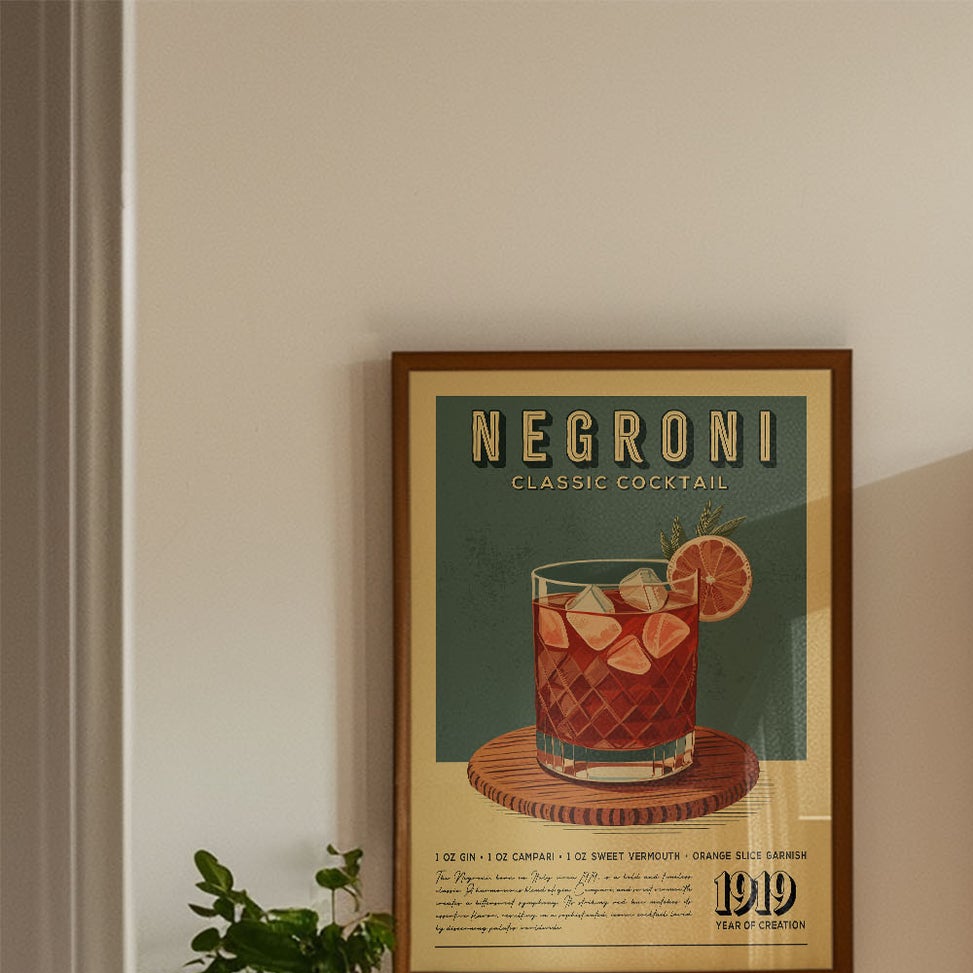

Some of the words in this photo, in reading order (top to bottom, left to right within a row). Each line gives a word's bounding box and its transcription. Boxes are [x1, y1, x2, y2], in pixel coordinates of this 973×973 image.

[471, 409, 775, 467] NEGRONI
[511, 474, 608, 491] CLASSIC
[616, 474, 729, 491] COCKTAIL
[435, 852, 439, 862] 1
[443, 852, 456, 862] OZ
[460, 852, 476, 862] GIN
[488, 852, 492, 861] 1
[496, 852, 508, 861] OZ
[512, 852, 555, 861] CAMPARI
[566, 852, 570, 861] 1
[574, 852, 587, 861] OZ
[591, 852, 625, 861] SWEET
[628, 852, 680, 861] VERMOUTH
[692, 851, 732, 860] ORANGE
[736, 851, 762, 860] SLICE
[766, 851, 807, 860] GARNISH
[714, 870, 797, 917] 1919
[716, 920, 741, 930] YEAR
[744, 920, 756, 930] OF
[758, 920, 806, 930] CREATION
